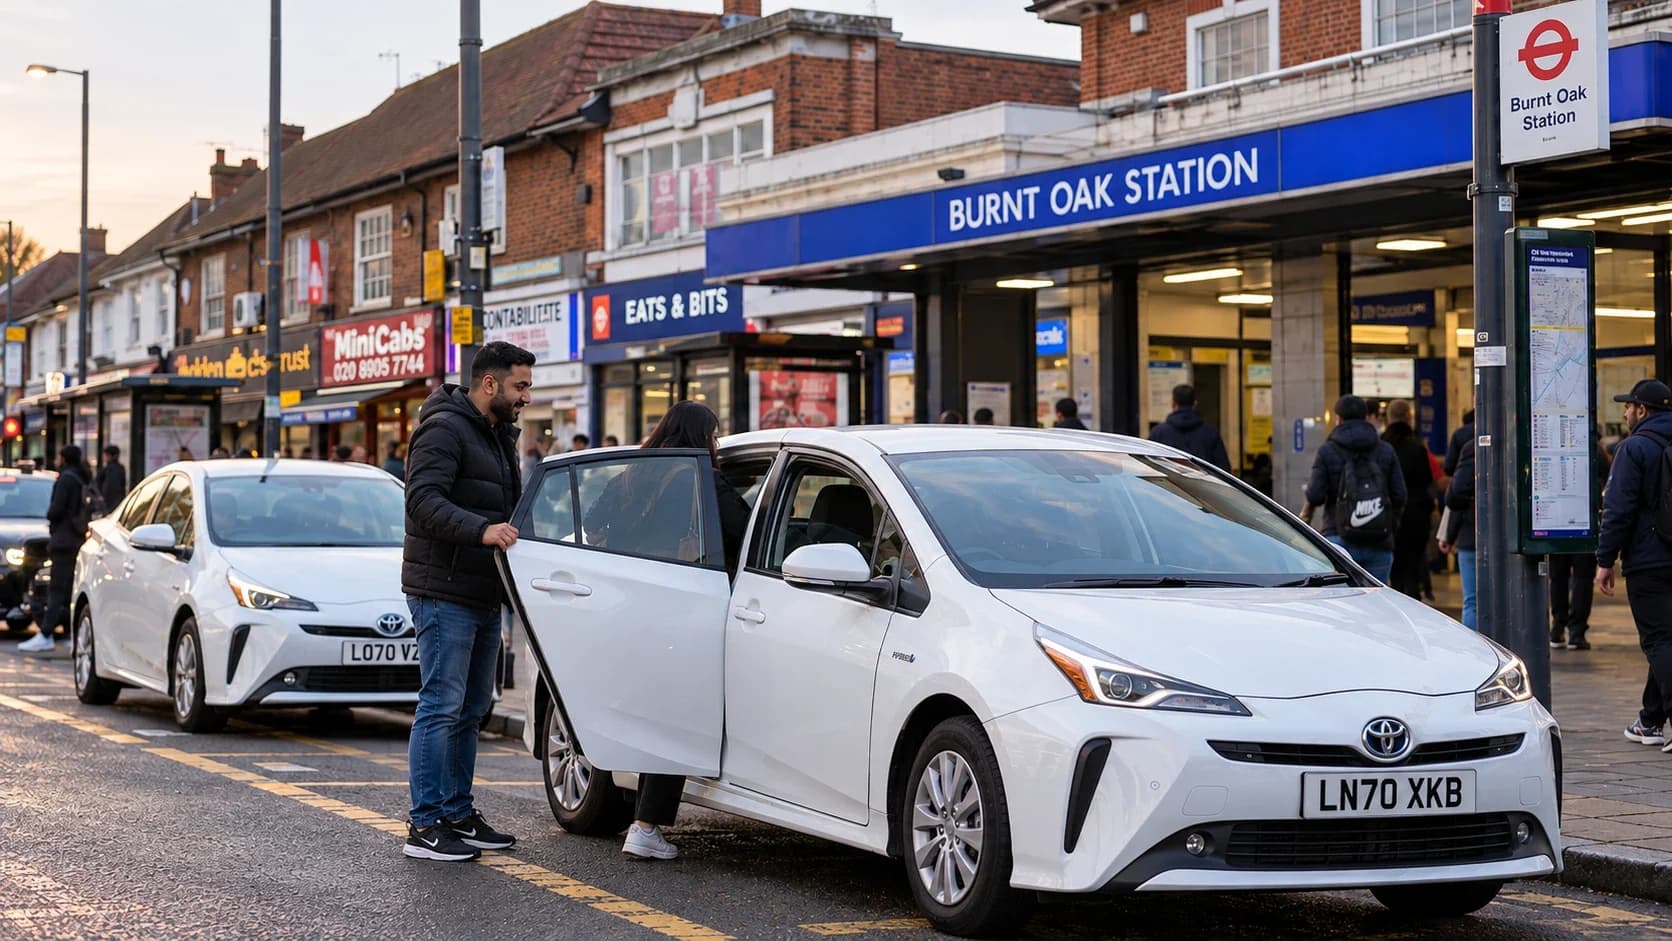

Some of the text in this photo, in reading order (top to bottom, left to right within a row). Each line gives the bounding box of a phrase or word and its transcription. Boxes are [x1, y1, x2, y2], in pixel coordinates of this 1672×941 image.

[1510, 85, 1588, 112] Burnt Oak
[1523, 110, 1576, 130] Station
[949, 147, 1258, 232] BURNT OAK STATION
[625, 287, 729, 325] EATS & BITS
[334, 320, 426, 361] MiniCabs
[333, 361, 357, 382] 020
[391, 353, 425, 376] 7744
[1355, 496, 1384, 516] NIKE
[1319, 777, 1463, 811] LN70 XKB
